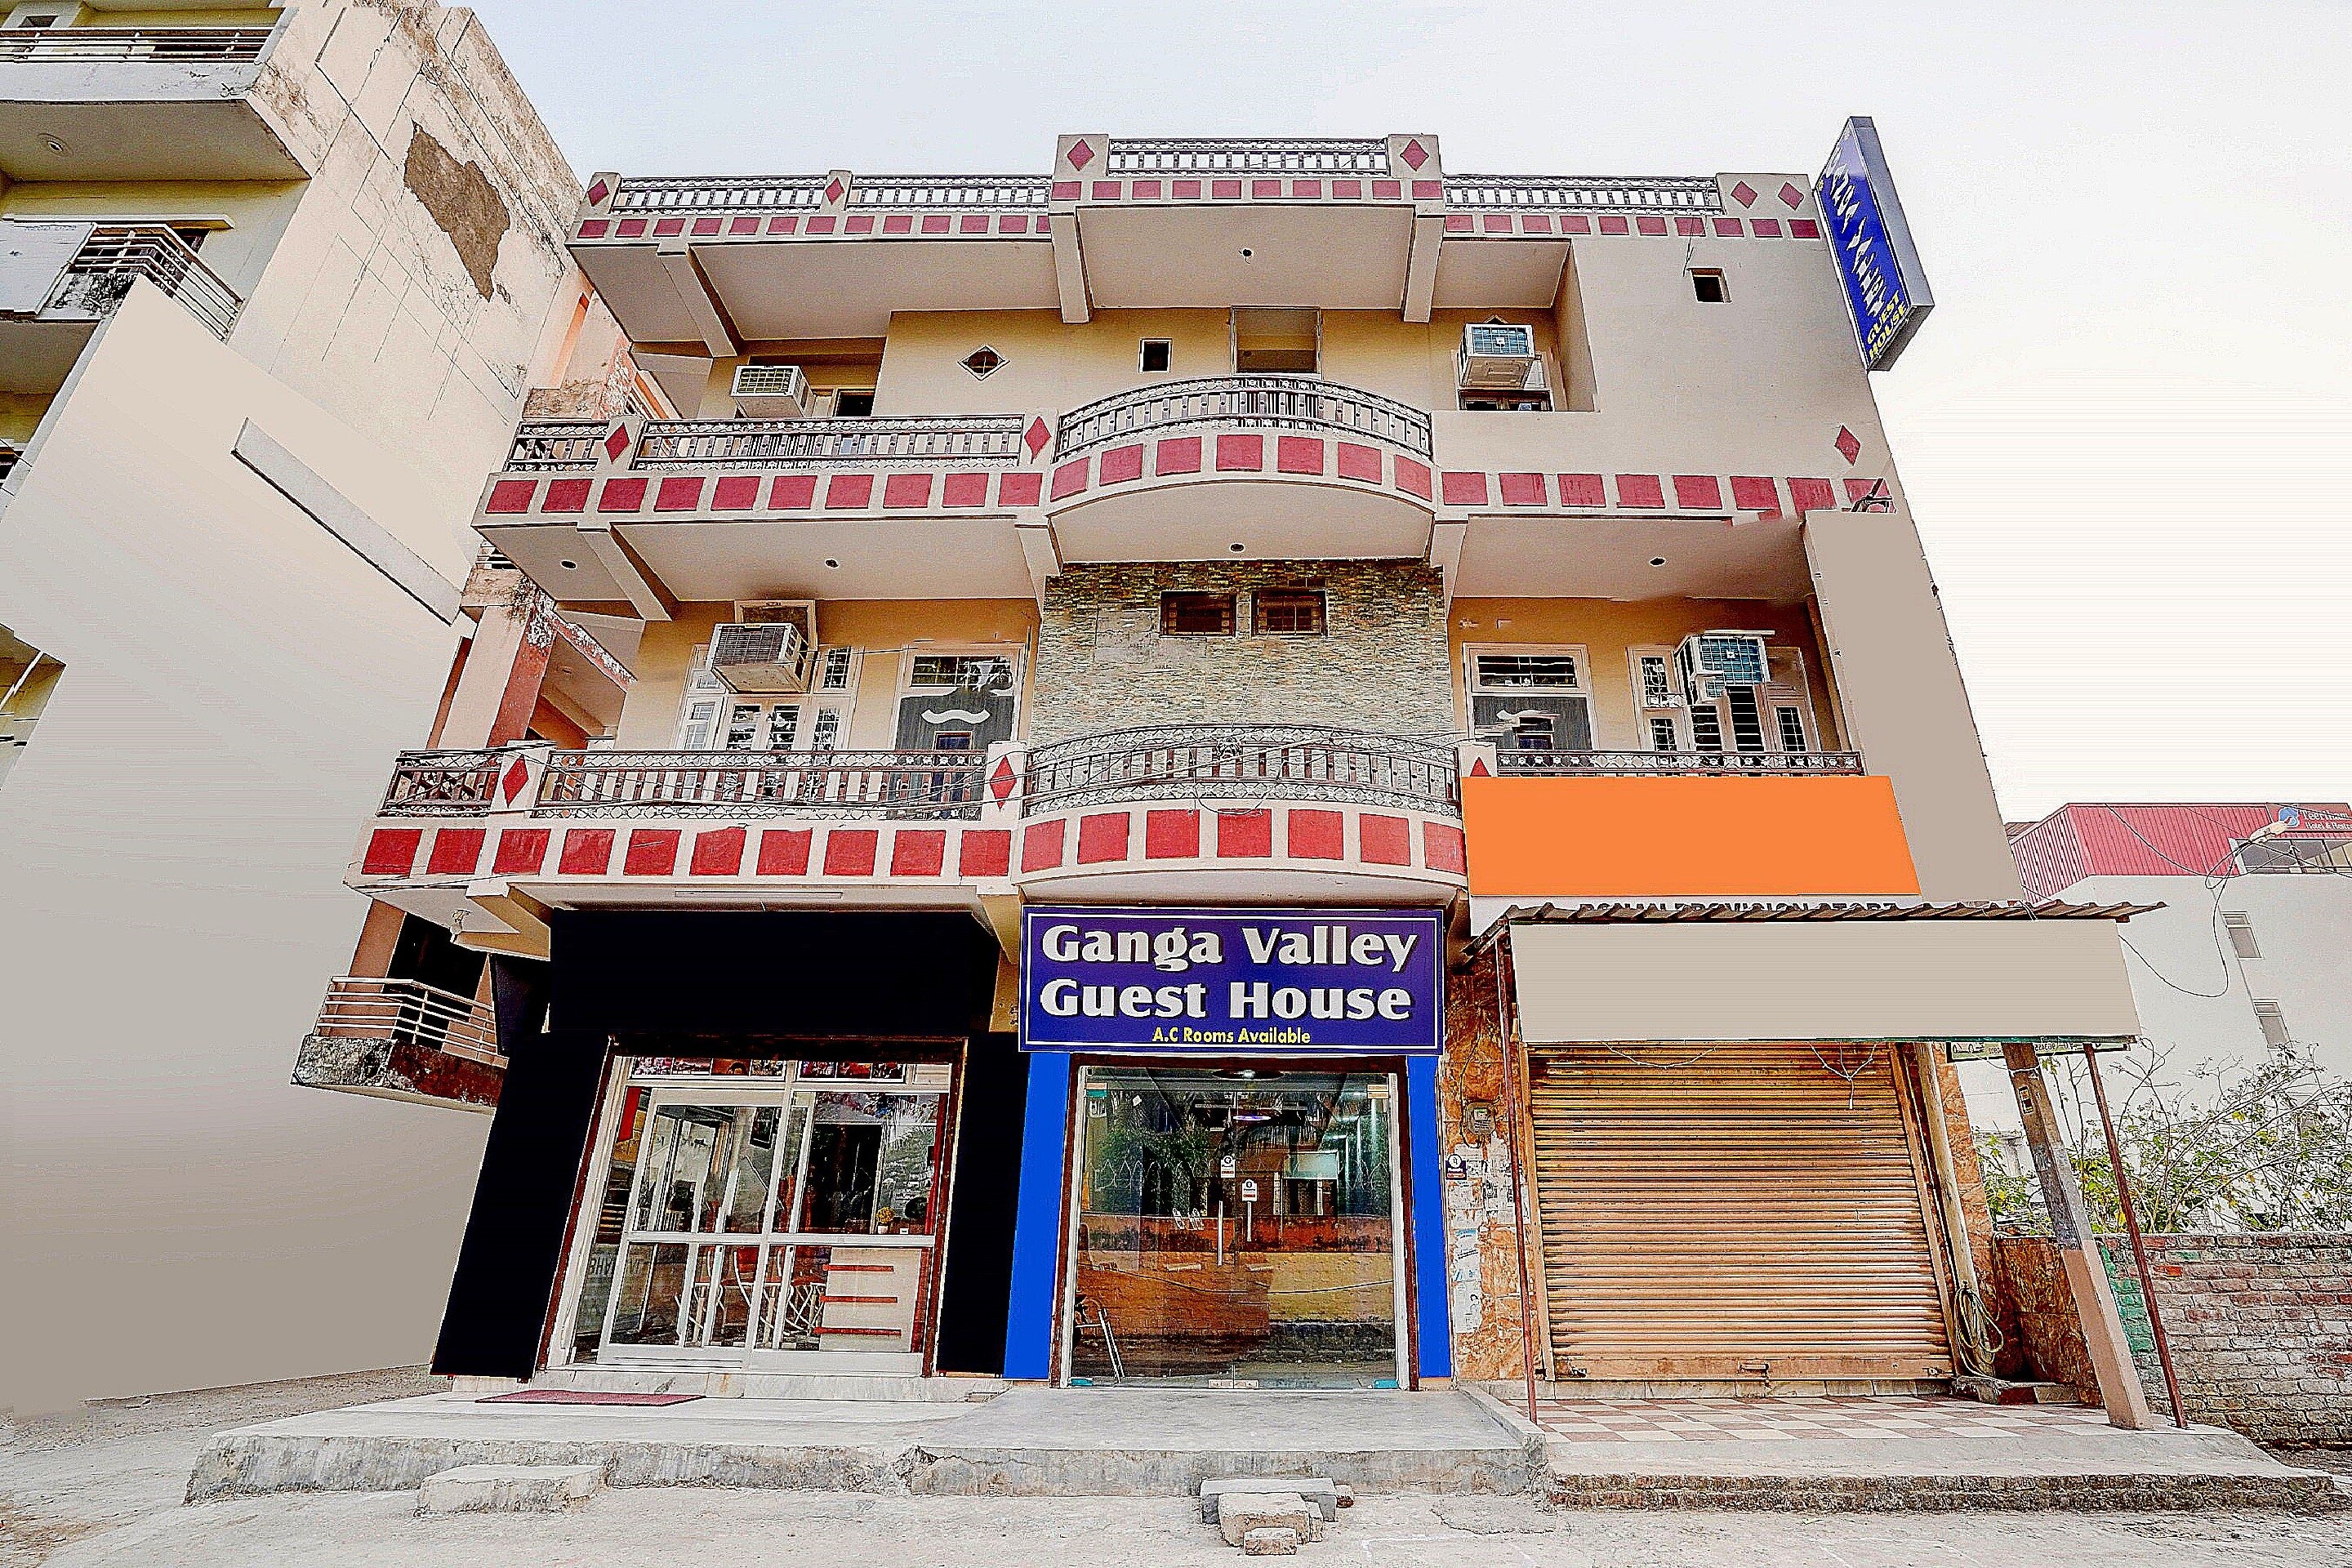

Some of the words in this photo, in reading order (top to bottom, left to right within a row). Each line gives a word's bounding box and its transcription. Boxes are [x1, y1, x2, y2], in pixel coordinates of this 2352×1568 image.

[1846, 216, 1887, 318] VALLEY
[1867, 290, 1900, 345] GUEST
[1868, 302, 1908, 359] HOUSE
[1041, 924, 1223, 972] Ganga
[1241, 925, 1419, 973] Valley
[1040, 978, 1208, 1018] Guest
[1230, 981, 1412, 1020] House
[1152, 1027, 1178, 1043] A.C
[1183, 1027, 1235, 1044] Rooms
[1238, 1027, 1311, 1044] Available
